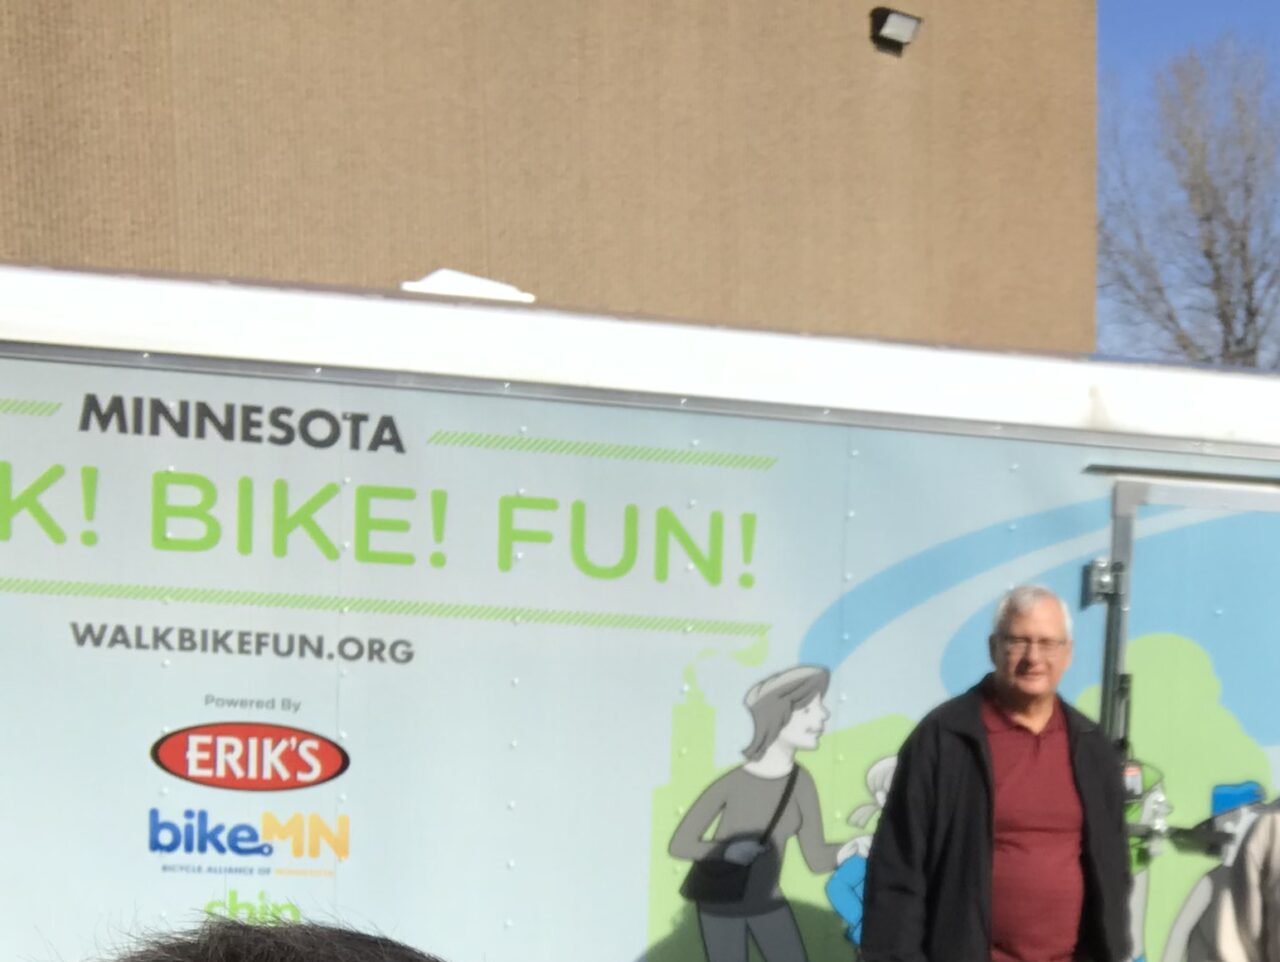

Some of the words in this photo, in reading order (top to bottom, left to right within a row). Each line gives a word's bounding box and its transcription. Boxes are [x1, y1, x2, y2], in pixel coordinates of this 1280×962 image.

[78, 392, 406, 454] MINNESOTA
[151, 470, 448, 569] BIKE!
[497, 494, 758, 589] FUN!
[70, 622, 416, 665] WALKBIKEFUN.ORG
[204, 693, 276, 711] Powered
[281, 697, 302, 713] By
[186, 734, 323, 782] ERIK'S
[148, 807, 350, 860] bikeMN
